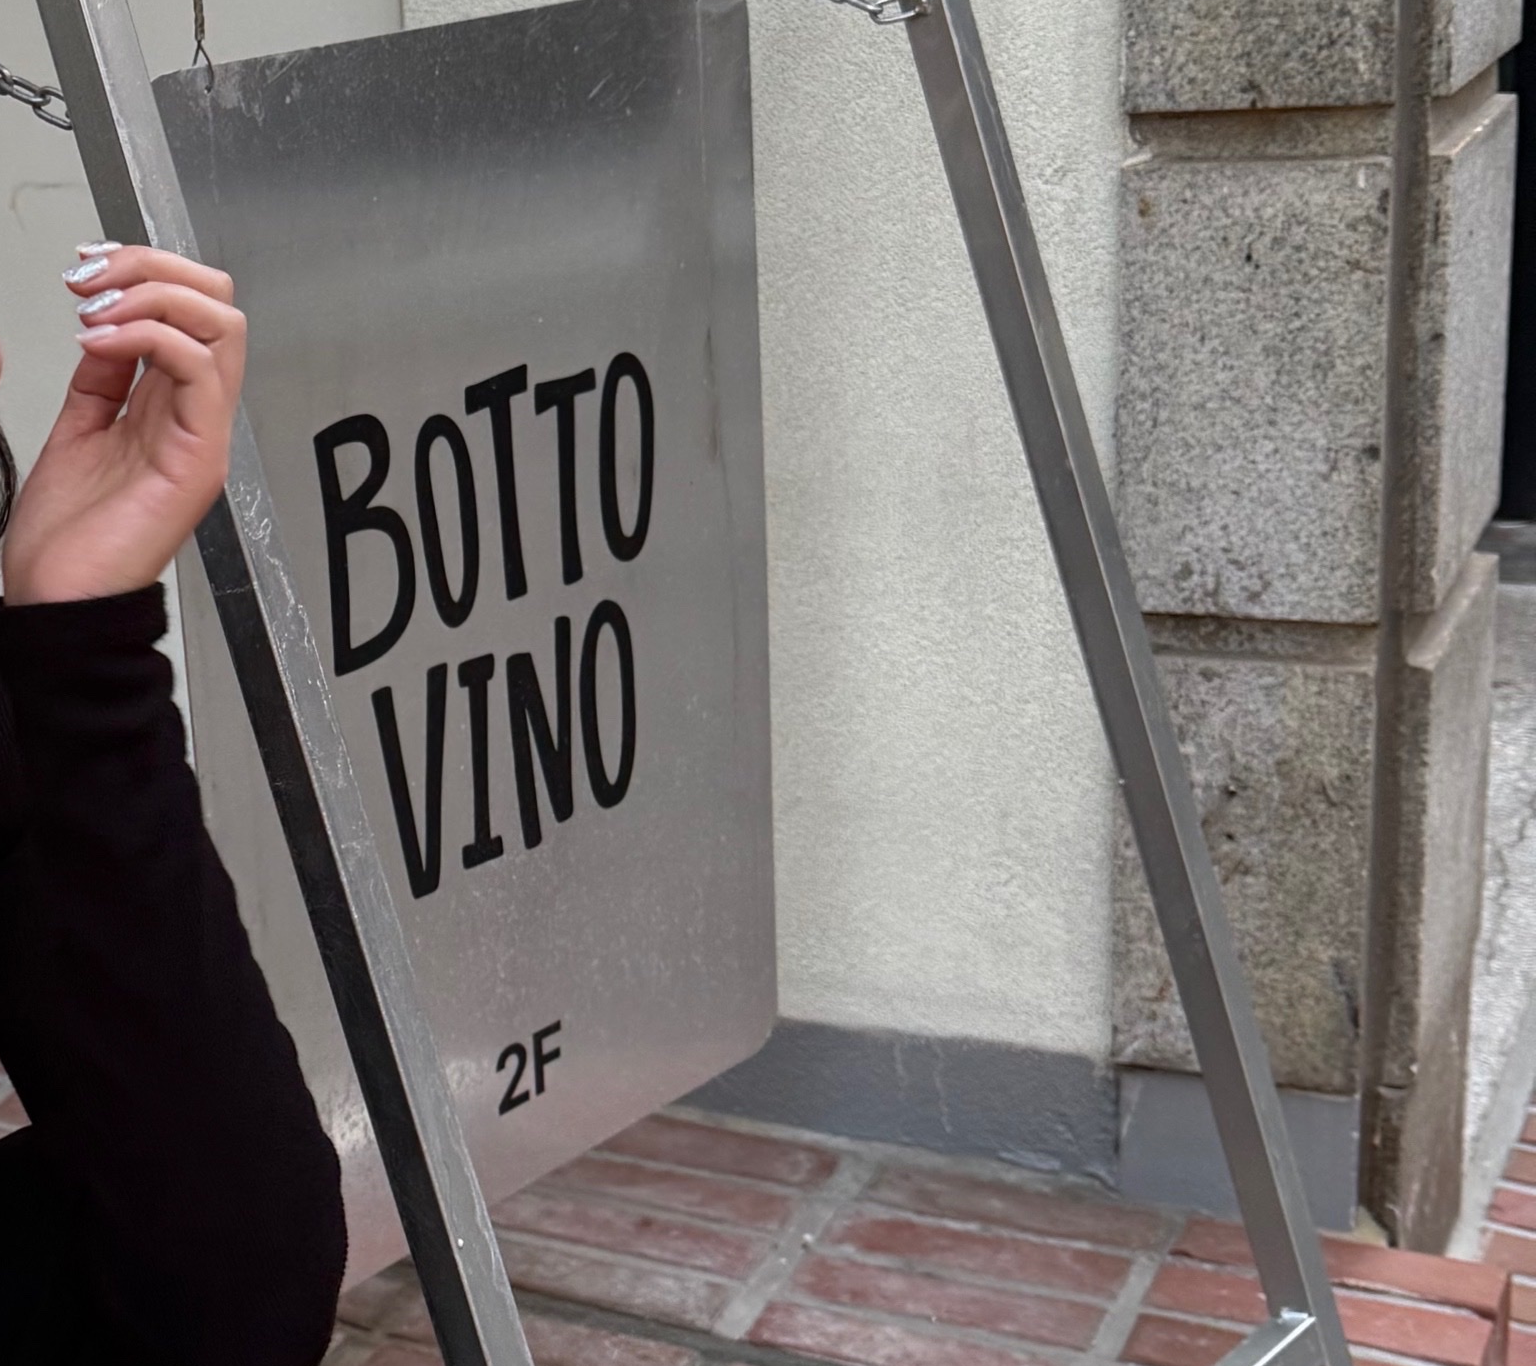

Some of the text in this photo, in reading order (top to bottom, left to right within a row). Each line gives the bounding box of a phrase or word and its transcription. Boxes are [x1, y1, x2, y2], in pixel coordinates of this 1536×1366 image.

[311, 350, 656, 679] BOTTO
[370, 598, 638, 901] VINO
[495, 1019, 563, 1117] 2F
